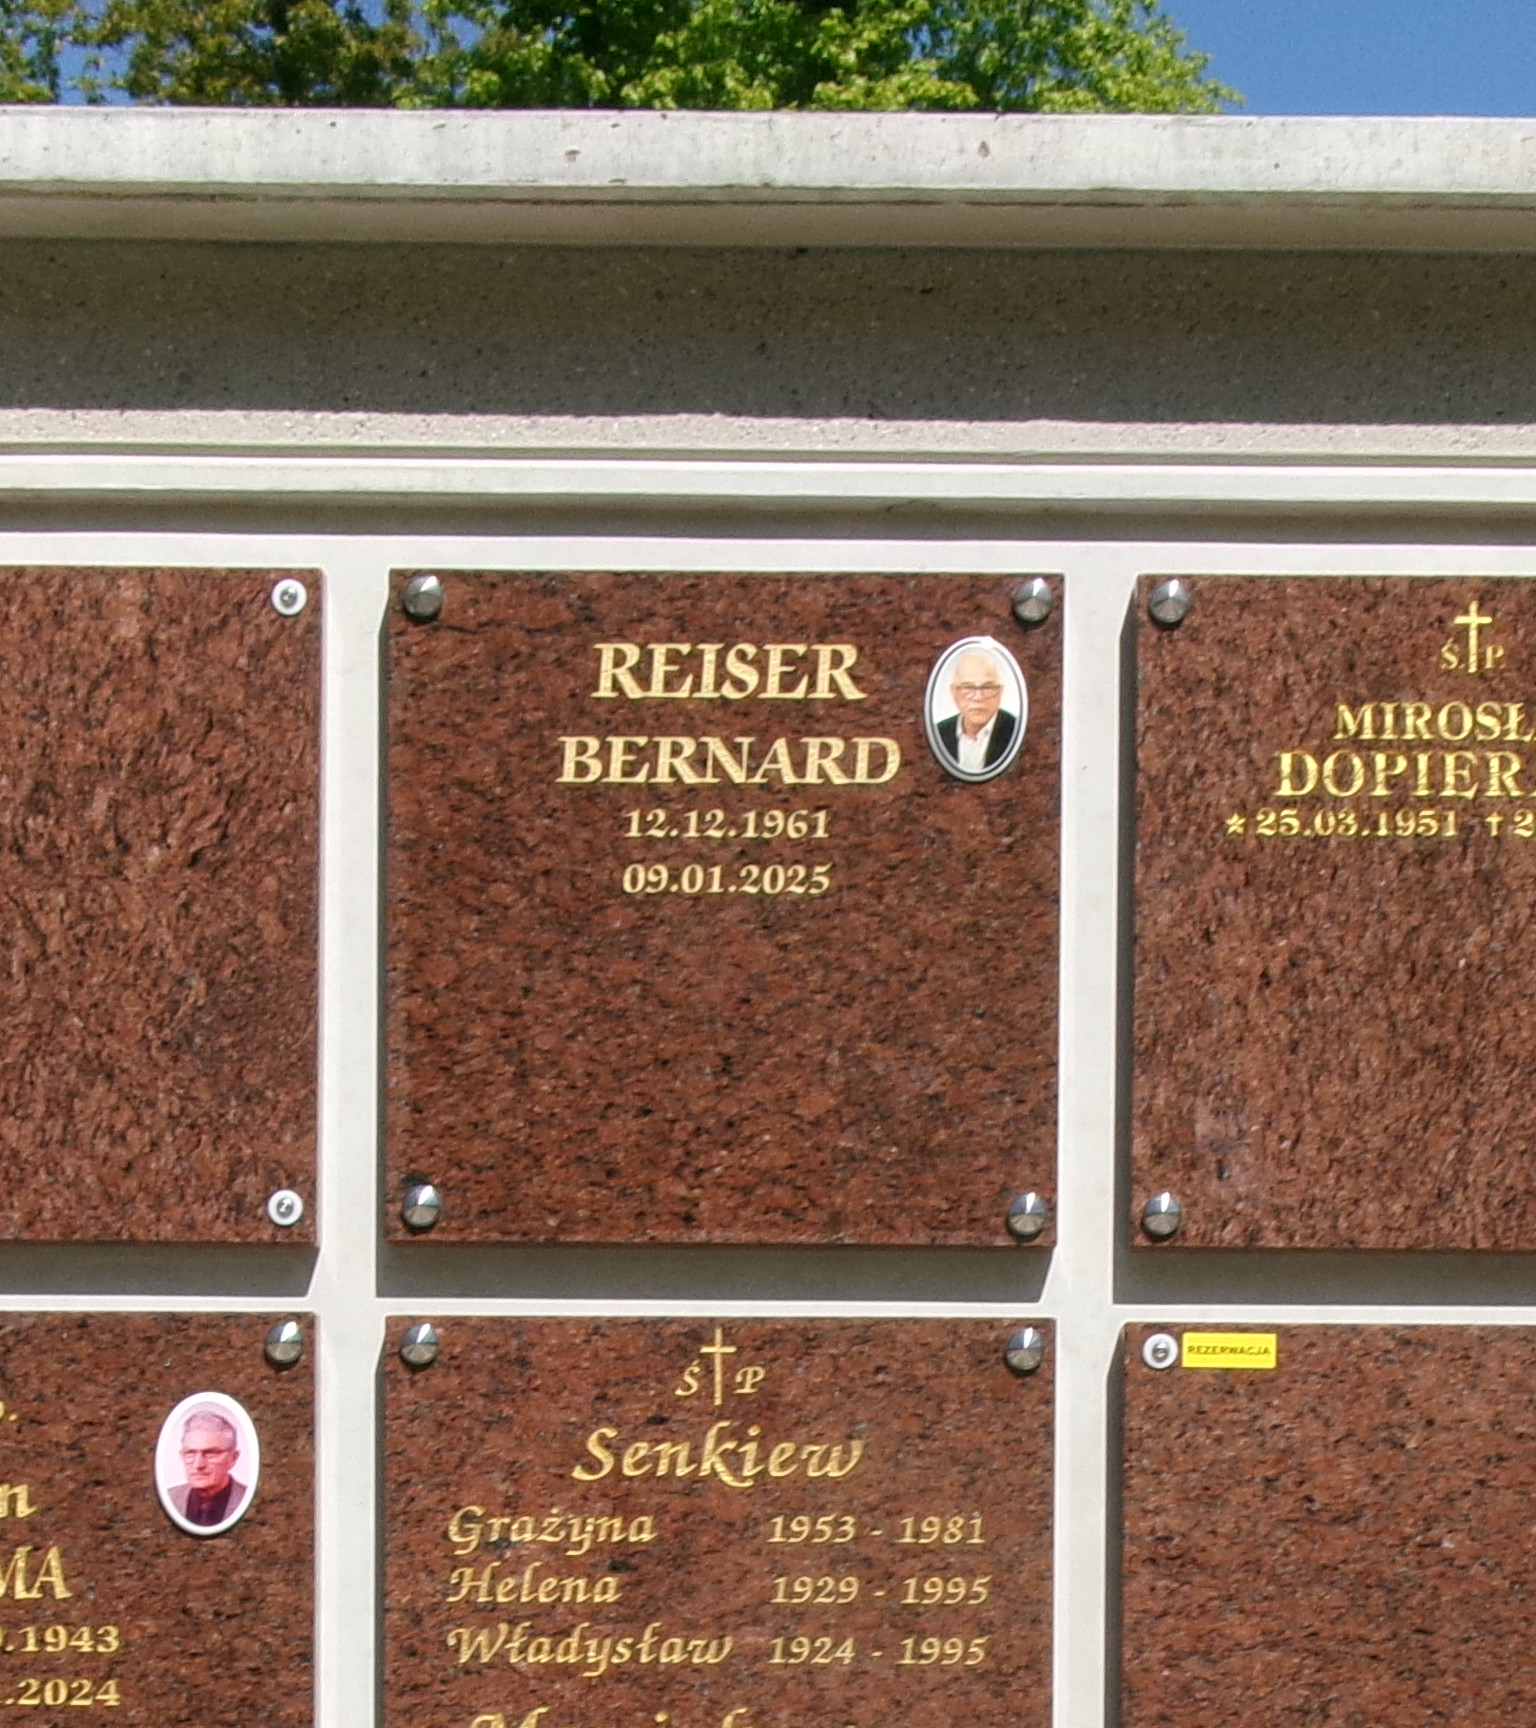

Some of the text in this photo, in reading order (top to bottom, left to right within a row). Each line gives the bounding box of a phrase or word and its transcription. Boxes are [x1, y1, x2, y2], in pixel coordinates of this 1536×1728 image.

[591, 642, 867, 700] REISER
[556, 736, 902, 785] BERNARD
[624, 809, 830, 839] 12.12.1961
[1255, 808, 1458, 838] 25.03.1951
[622, 863, 833, 895] 09.01.2025
[1187, 1345, 1271, 1357] REZERWACJA
[571, 1420, 864, 1488] Senkiew
[447, 1505, 659, 1556] Grażyna
[766, 1514, 857, 1544] 1953
[897, 1513, 986, 1544] 1981
[446, 1561, 623, 1604] Helena
[771, 1576, 860, 1604] 1929
[900, 1576, 991, 1604] 1995
[447, 1622, 732, 1677] Władysław
[767, 1636, 855, 1666] 1924
[895, 1636, 988, 1666] 1995
